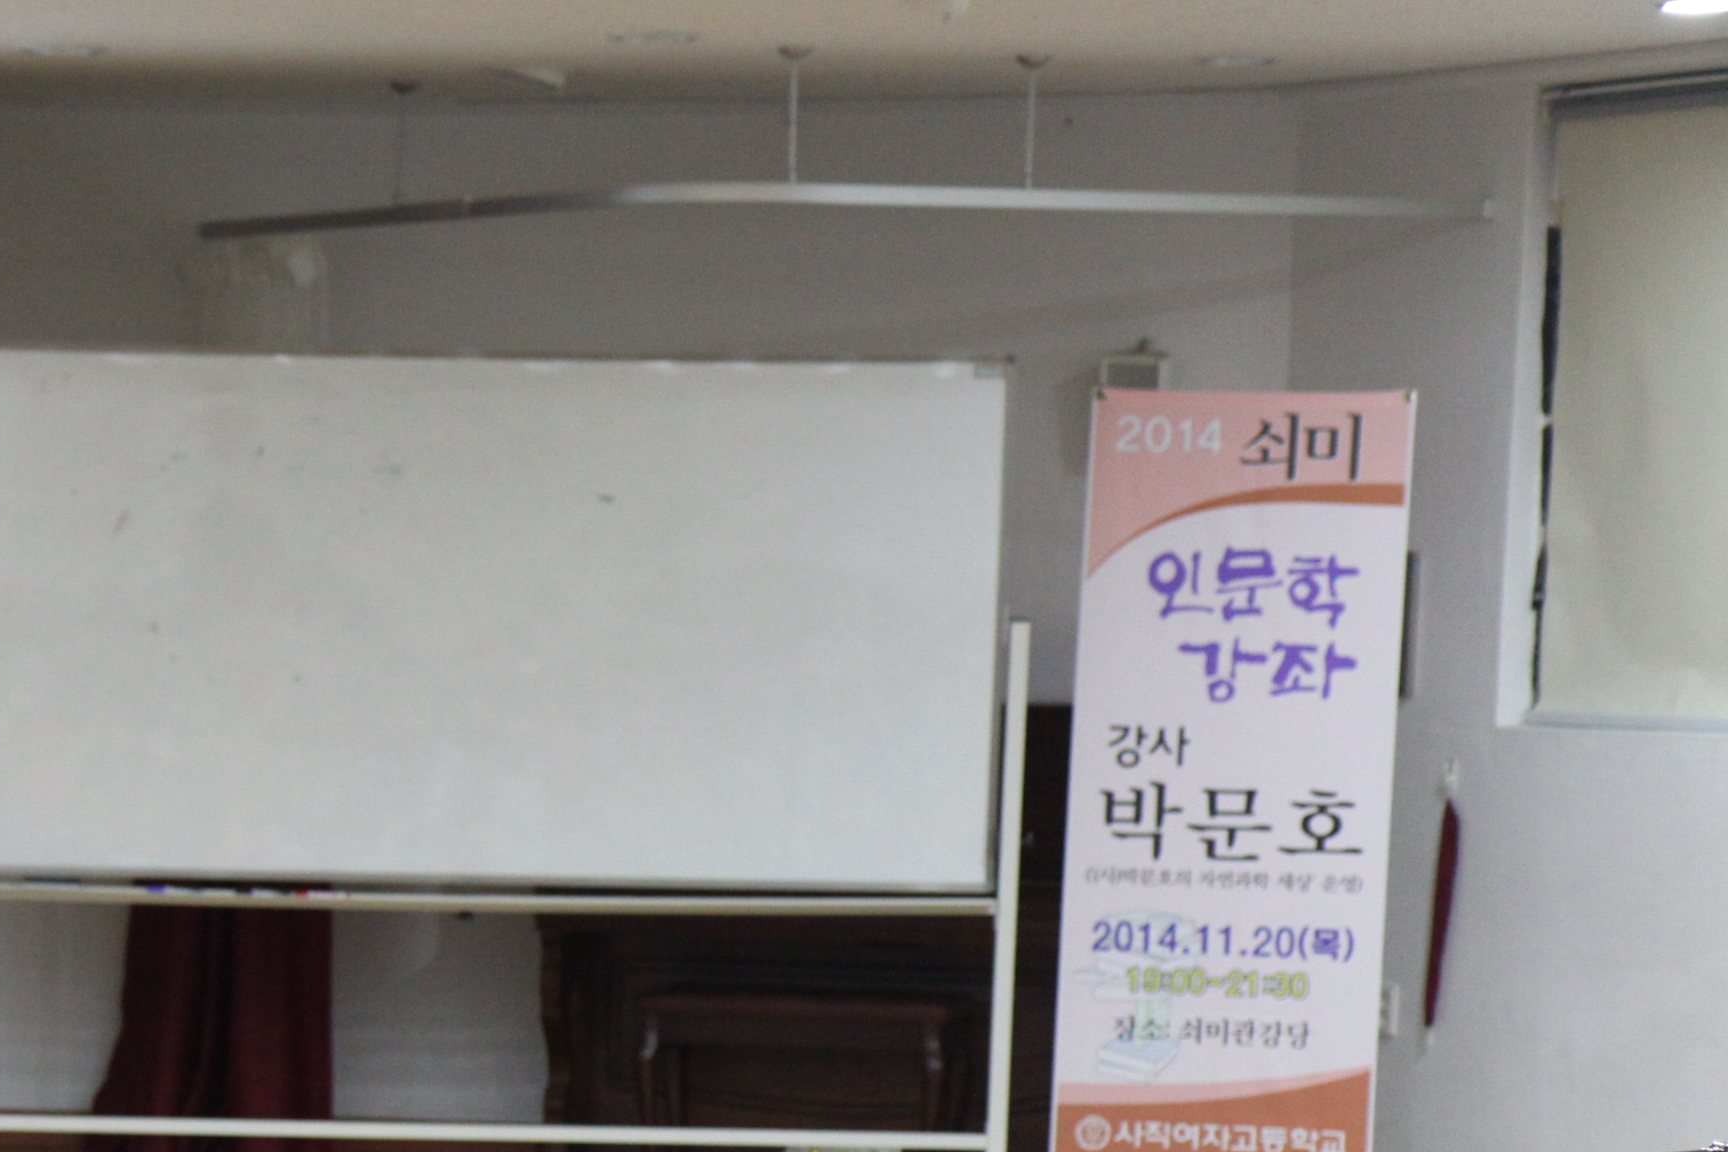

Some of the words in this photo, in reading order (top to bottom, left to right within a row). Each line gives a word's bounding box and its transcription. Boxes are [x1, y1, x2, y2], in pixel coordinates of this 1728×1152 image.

[1115, 415, 1224, 454] 2014
[1239, 411, 1363, 481] 쇠미
[1148, 546, 1360, 629] 인문학
[1178, 637, 1358, 703] 강좌
[1108, 725, 1190, 768] 강사
[1100, 780, 1364, 861] 박문호
[1092, 919, 1356, 962] 2014.11.20(목)
